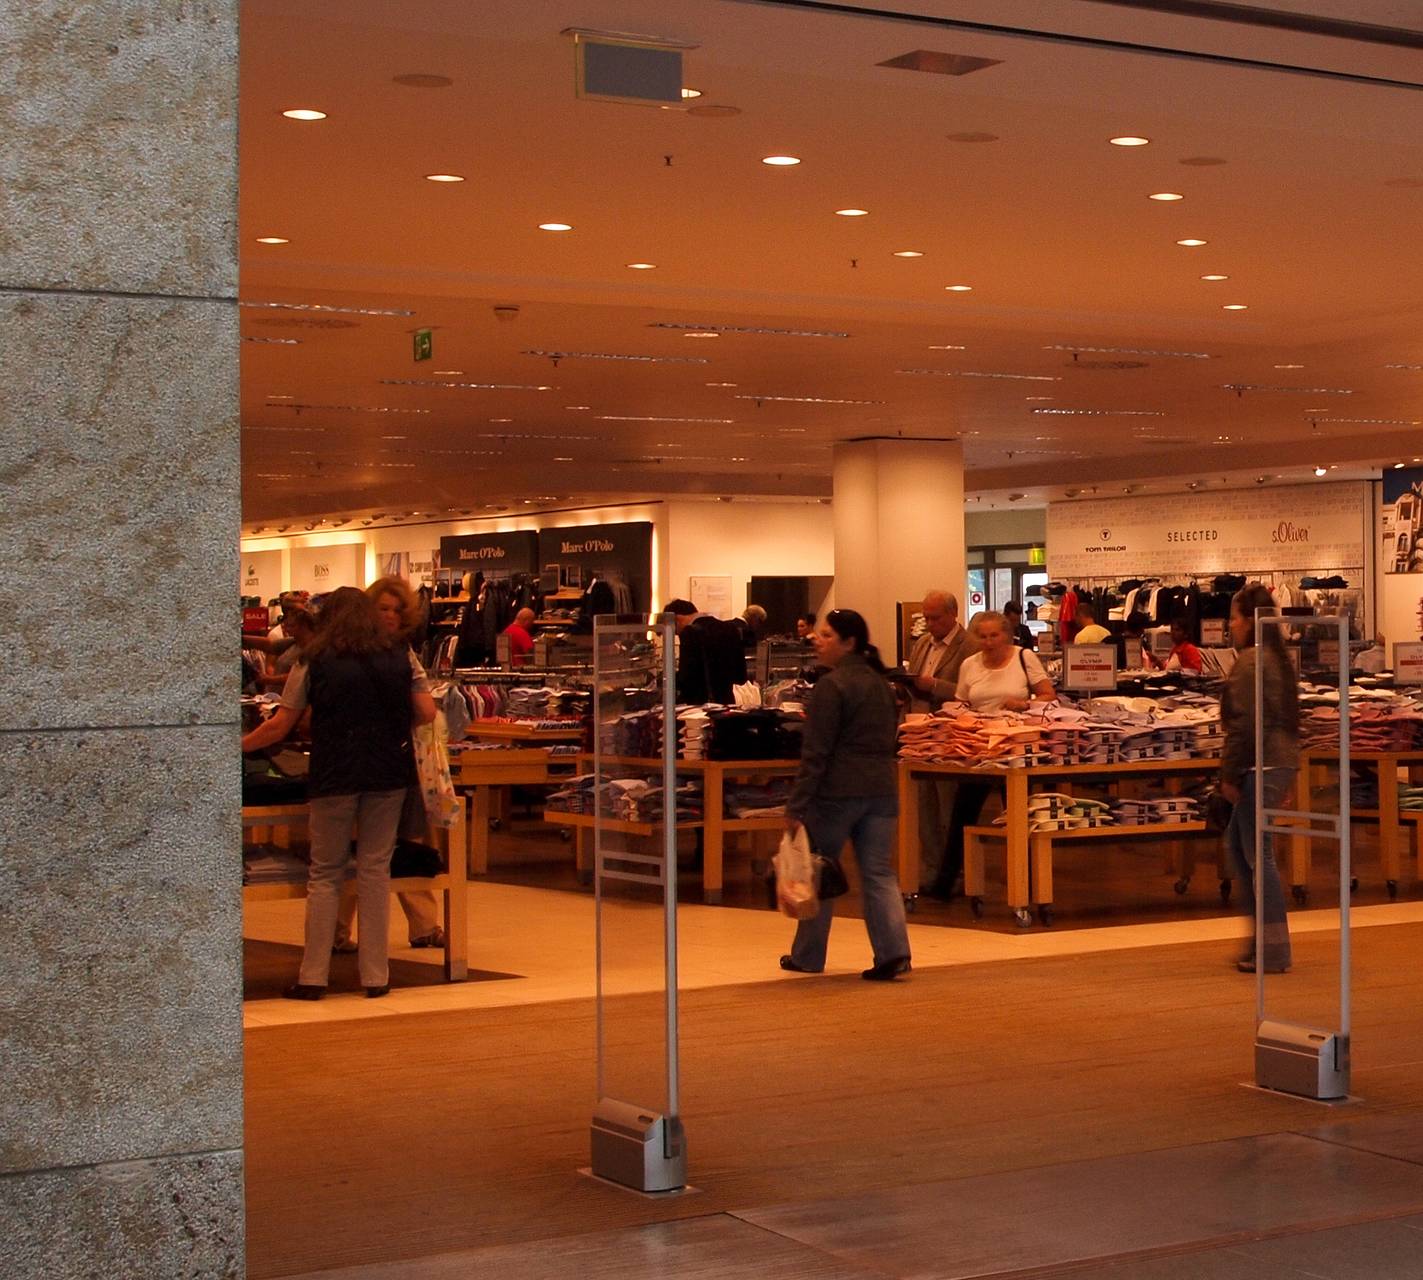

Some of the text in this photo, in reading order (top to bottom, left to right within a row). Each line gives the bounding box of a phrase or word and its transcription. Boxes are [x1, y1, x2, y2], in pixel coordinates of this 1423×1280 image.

[1167, 530, 1218, 542] SELECTED
[561, 540, 613, 553] Marc O'Polo
[459, 548, 504, 560] Marc O'Polo
